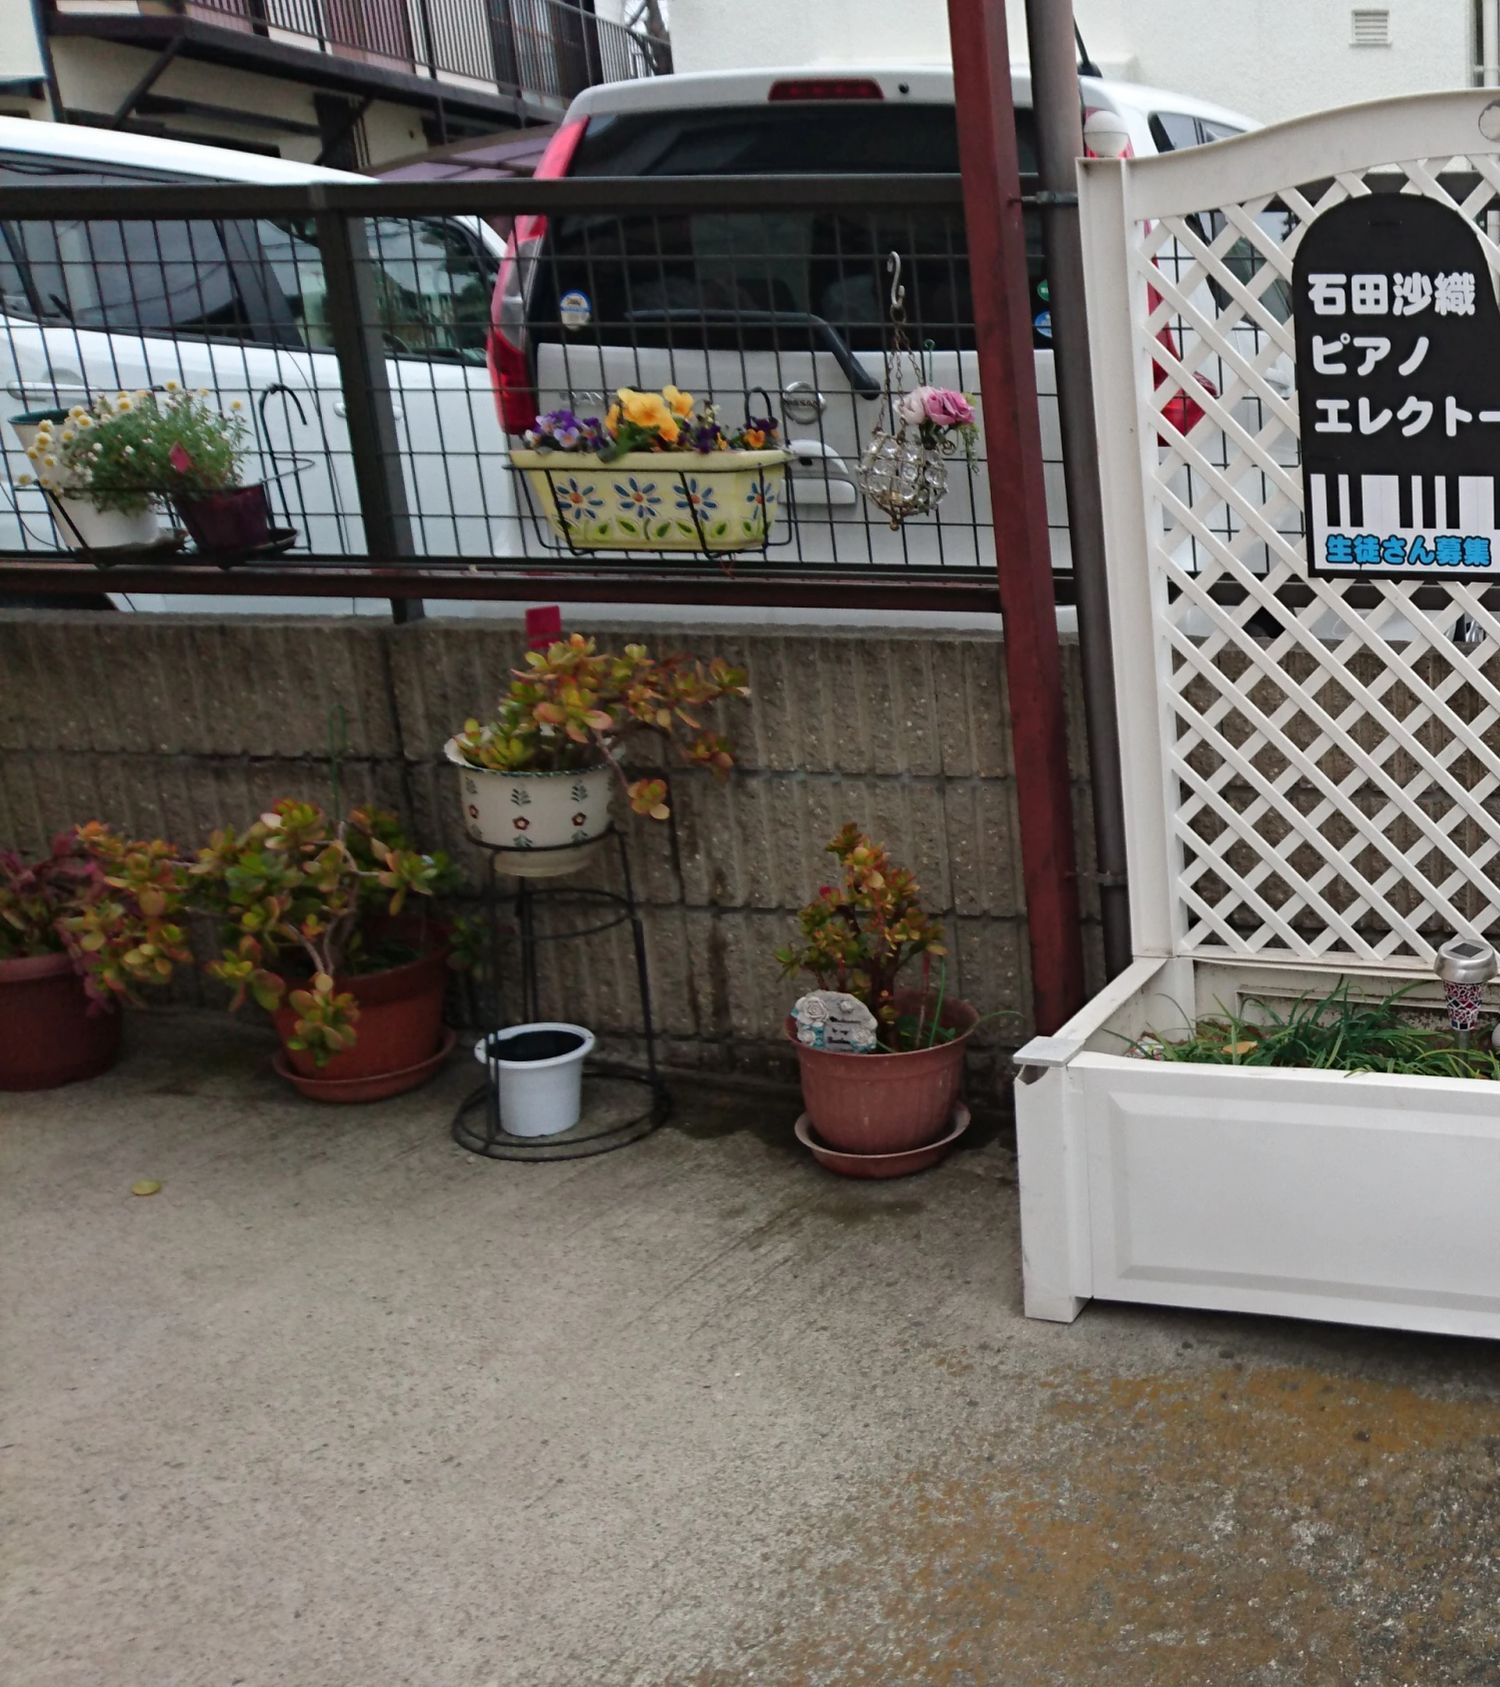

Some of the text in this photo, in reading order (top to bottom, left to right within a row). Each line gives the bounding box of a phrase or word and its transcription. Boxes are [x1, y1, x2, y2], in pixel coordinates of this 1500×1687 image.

[1308, 271, 1476, 315] 石田沙織
[1313, 333, 1429, 375] ピアノ
[1325, 535, 1491, 566] 生徒さん募集
